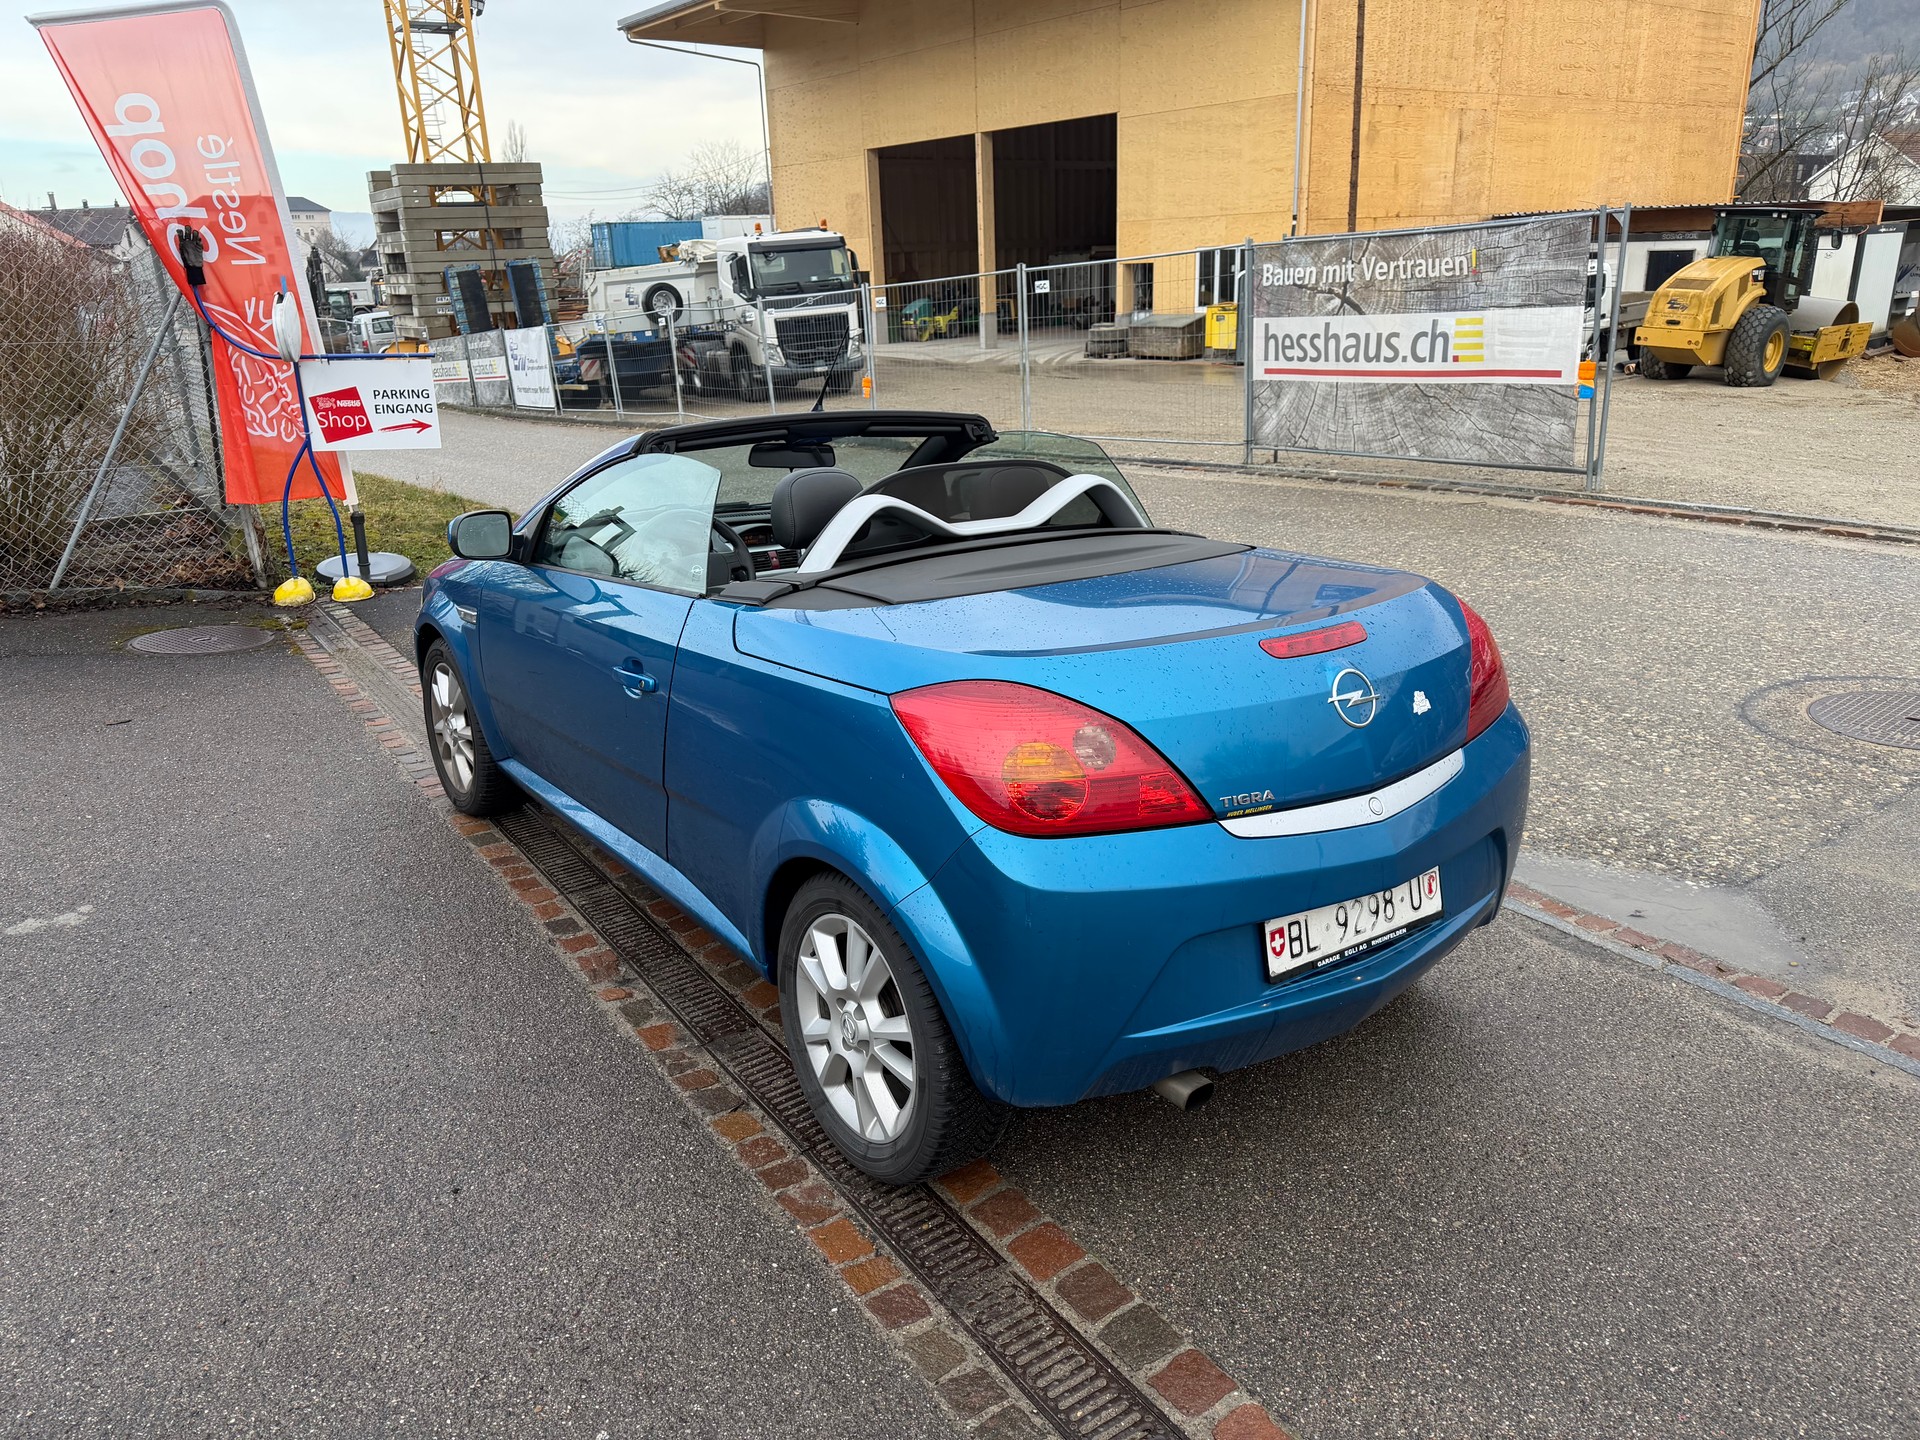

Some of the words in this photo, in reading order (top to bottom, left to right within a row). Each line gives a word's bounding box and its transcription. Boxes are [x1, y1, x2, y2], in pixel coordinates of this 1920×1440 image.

[1262, 263, 1316, 287] Bauen
[1322, 260, 1355, 283] mit
[1361, 248, 1478, 281] Vertrauen!
[1263, 318, 1450, 364] hesshaus.ch
[373, 388, 430, 400] PARKING
[374, 403, 433, 415] EINGANG
[316, 410, 367, 432] Shop
[1219, 789, 1275, 808] TIGRA
[1287, 914, 1321, 959] BL
[1335, 888, 1395, 944] 9298
[1317, 954, 1341, 968] GARAGE
[1344, 945, 1359, 957] EGLI
[1359, 942, 1368, 952] AG
[1371, 927, 1407, 947] RHEINFELDEN
